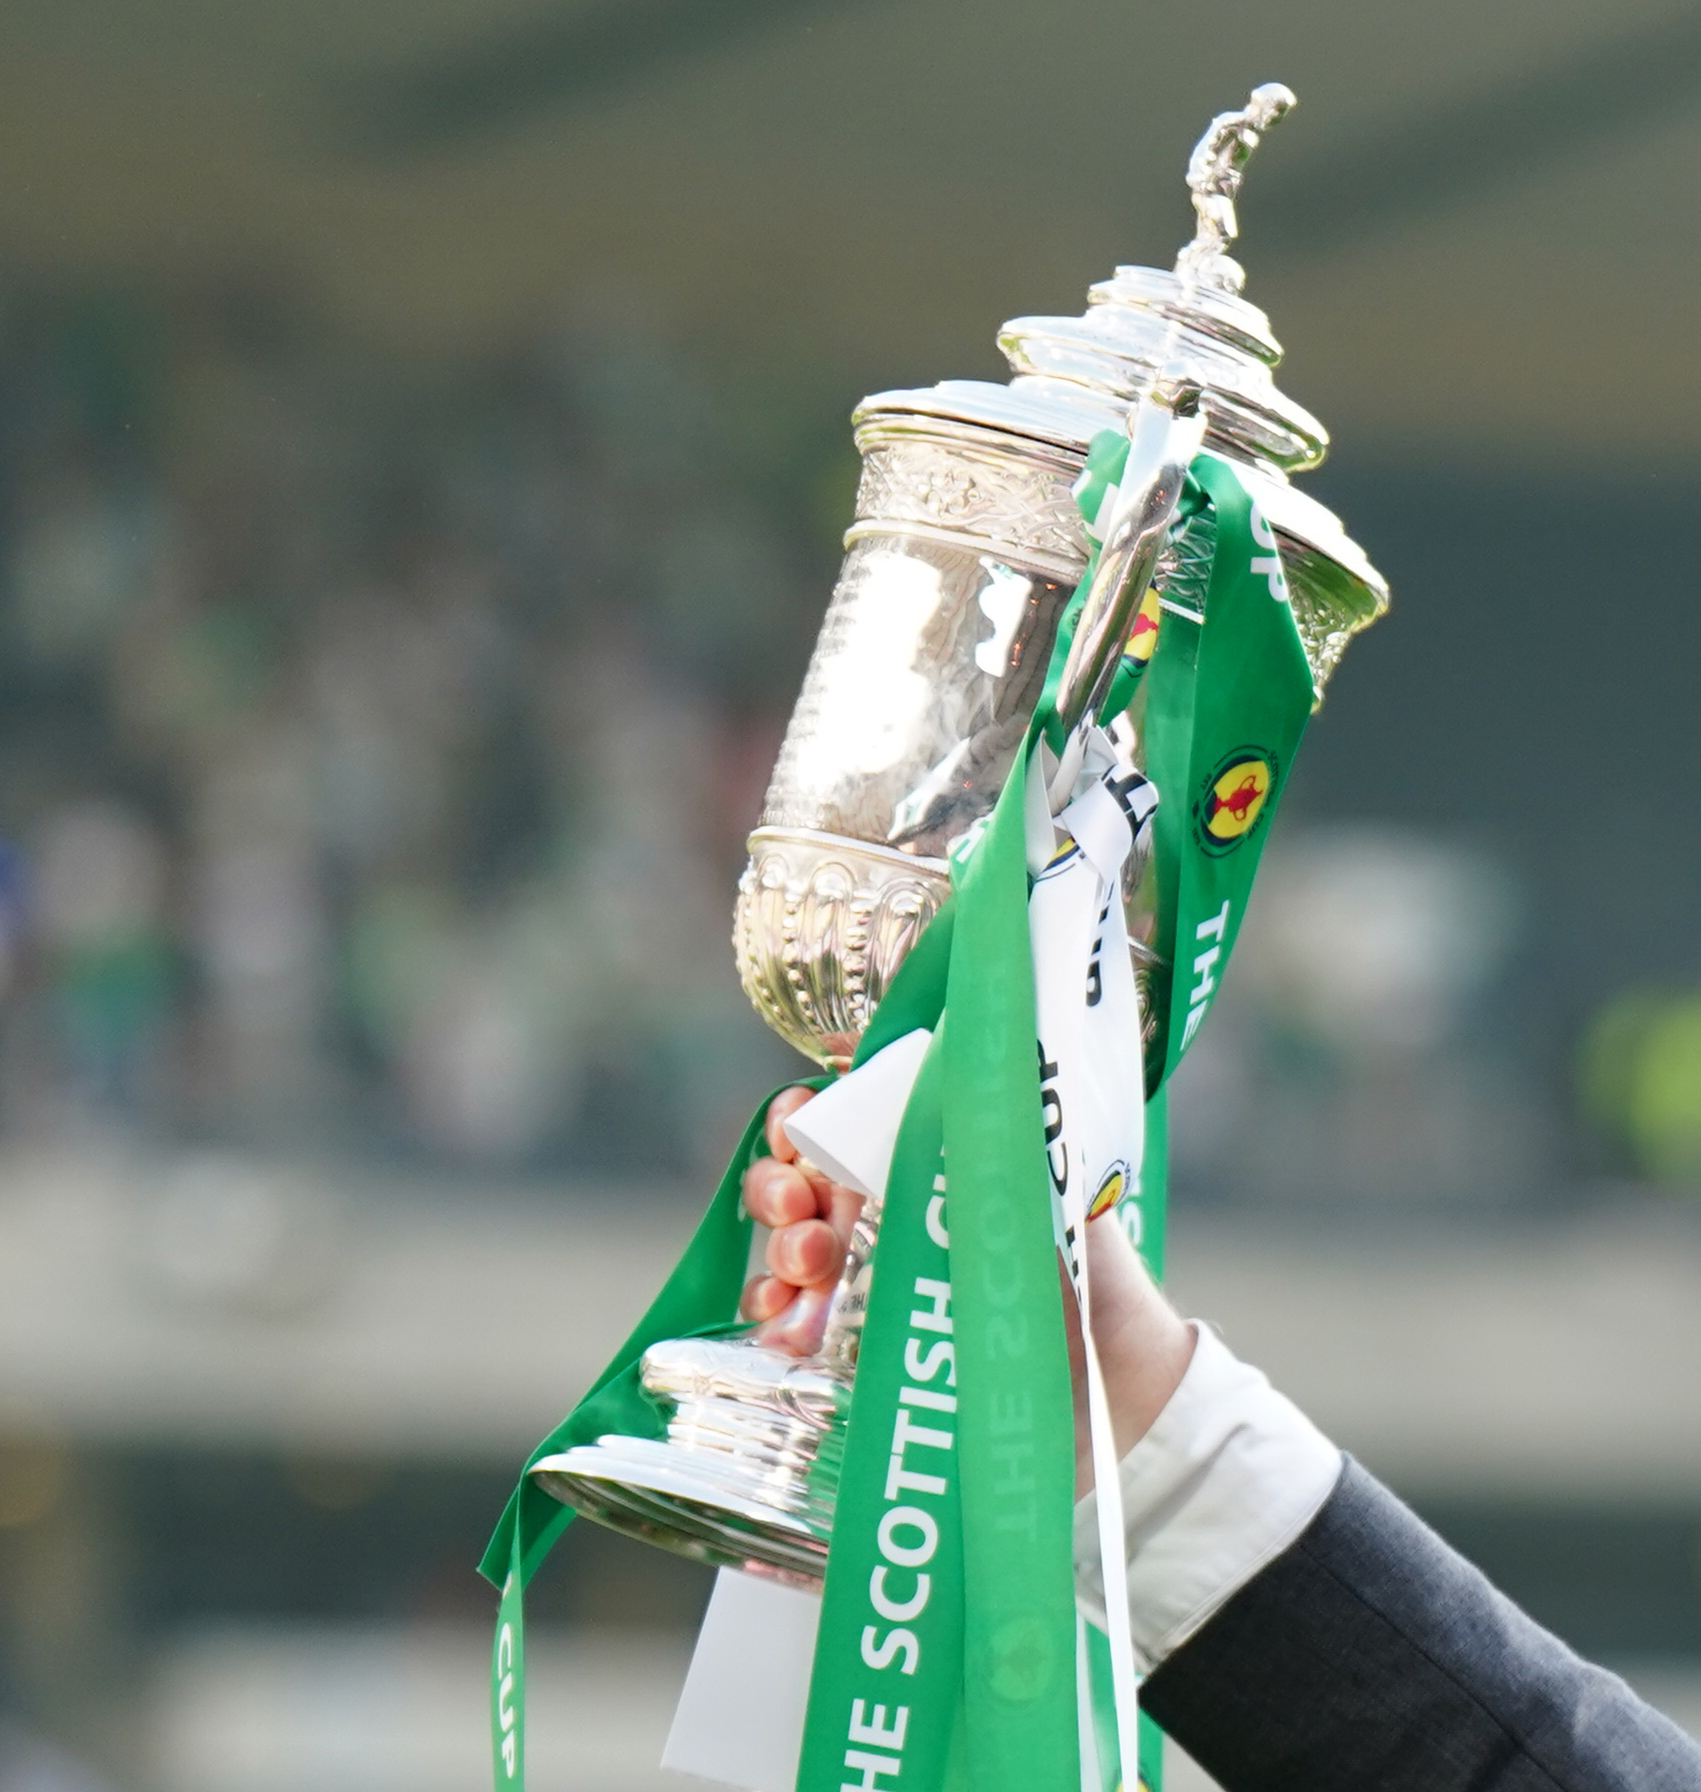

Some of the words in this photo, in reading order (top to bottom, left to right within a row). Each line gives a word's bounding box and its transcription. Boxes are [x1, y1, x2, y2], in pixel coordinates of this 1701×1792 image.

[1250, 501, 1290, 602] UP
[1179, 899, 1230, 1052] THE
[860, 1276, 958, 1676] SCOTTISH
[497, 1622, 516, 1779] CUP
